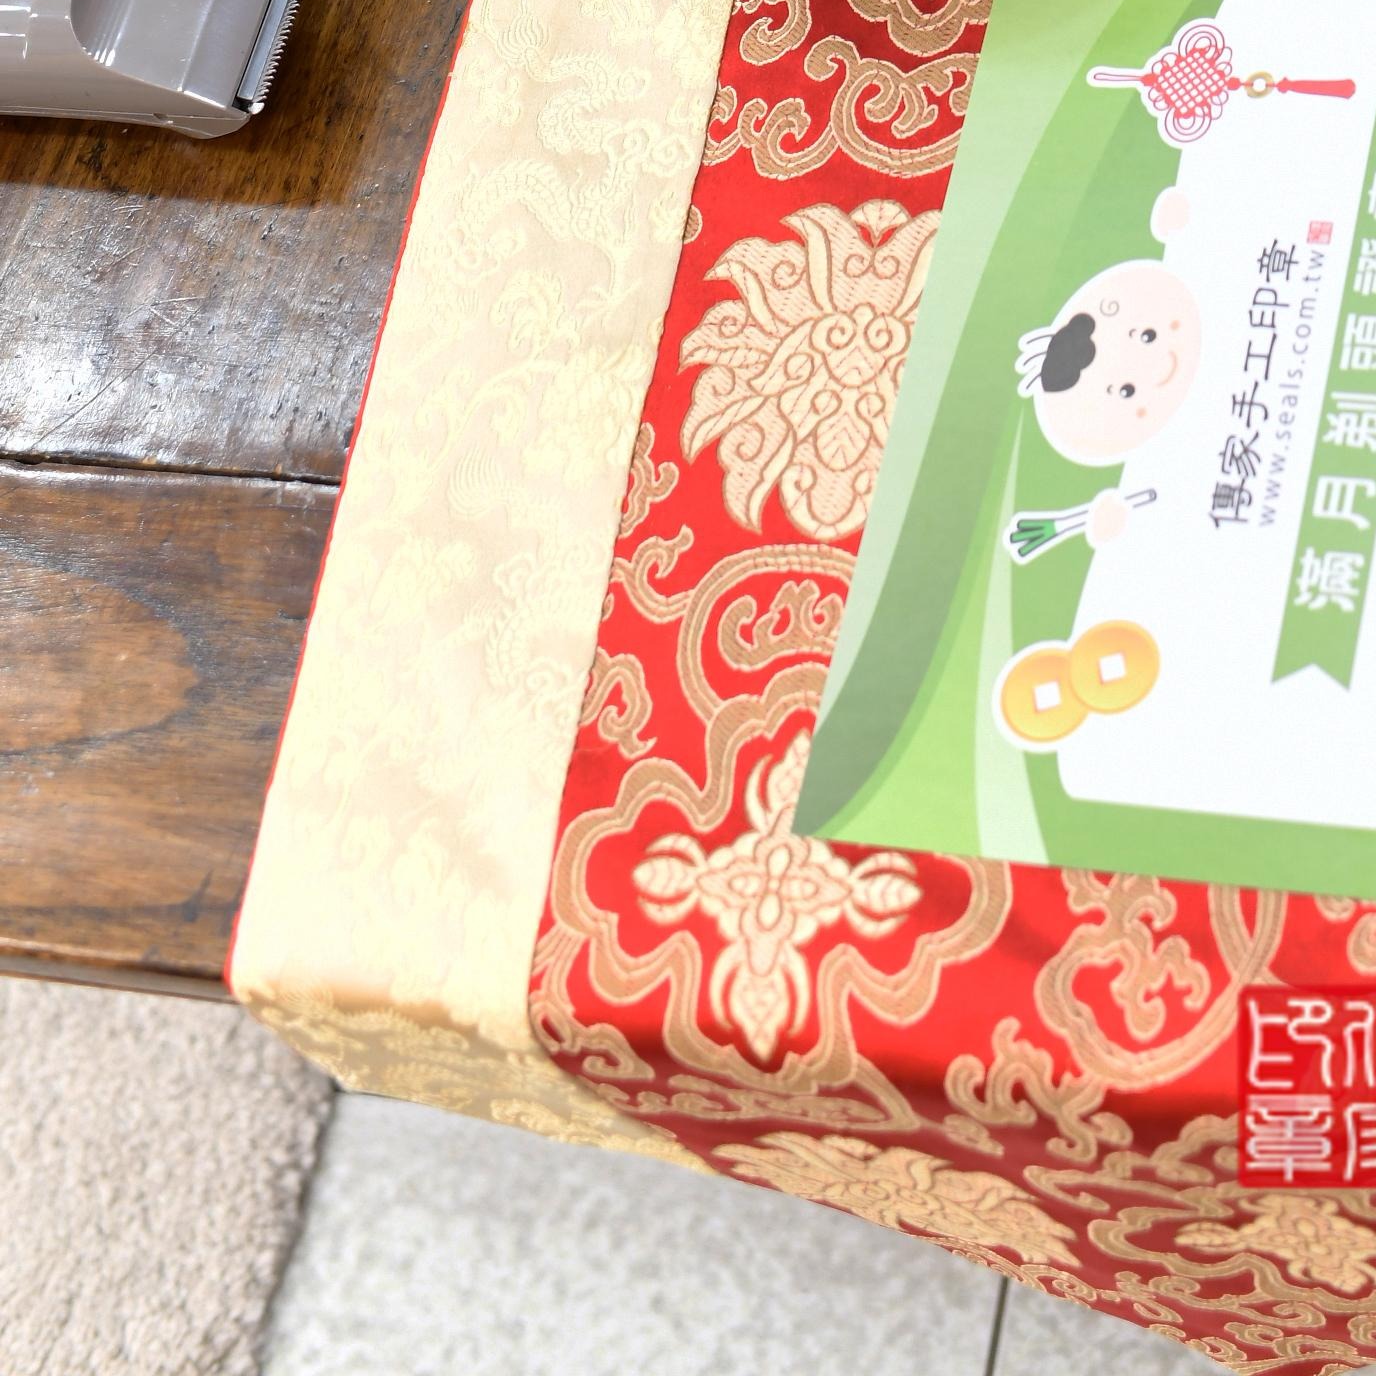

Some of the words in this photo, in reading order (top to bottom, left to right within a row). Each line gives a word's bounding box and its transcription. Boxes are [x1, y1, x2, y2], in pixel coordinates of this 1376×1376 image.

[1208, 238, 1300, 529] 傳家手工印章
[1258, 248, 1326, 527] www.seals.com.tw
